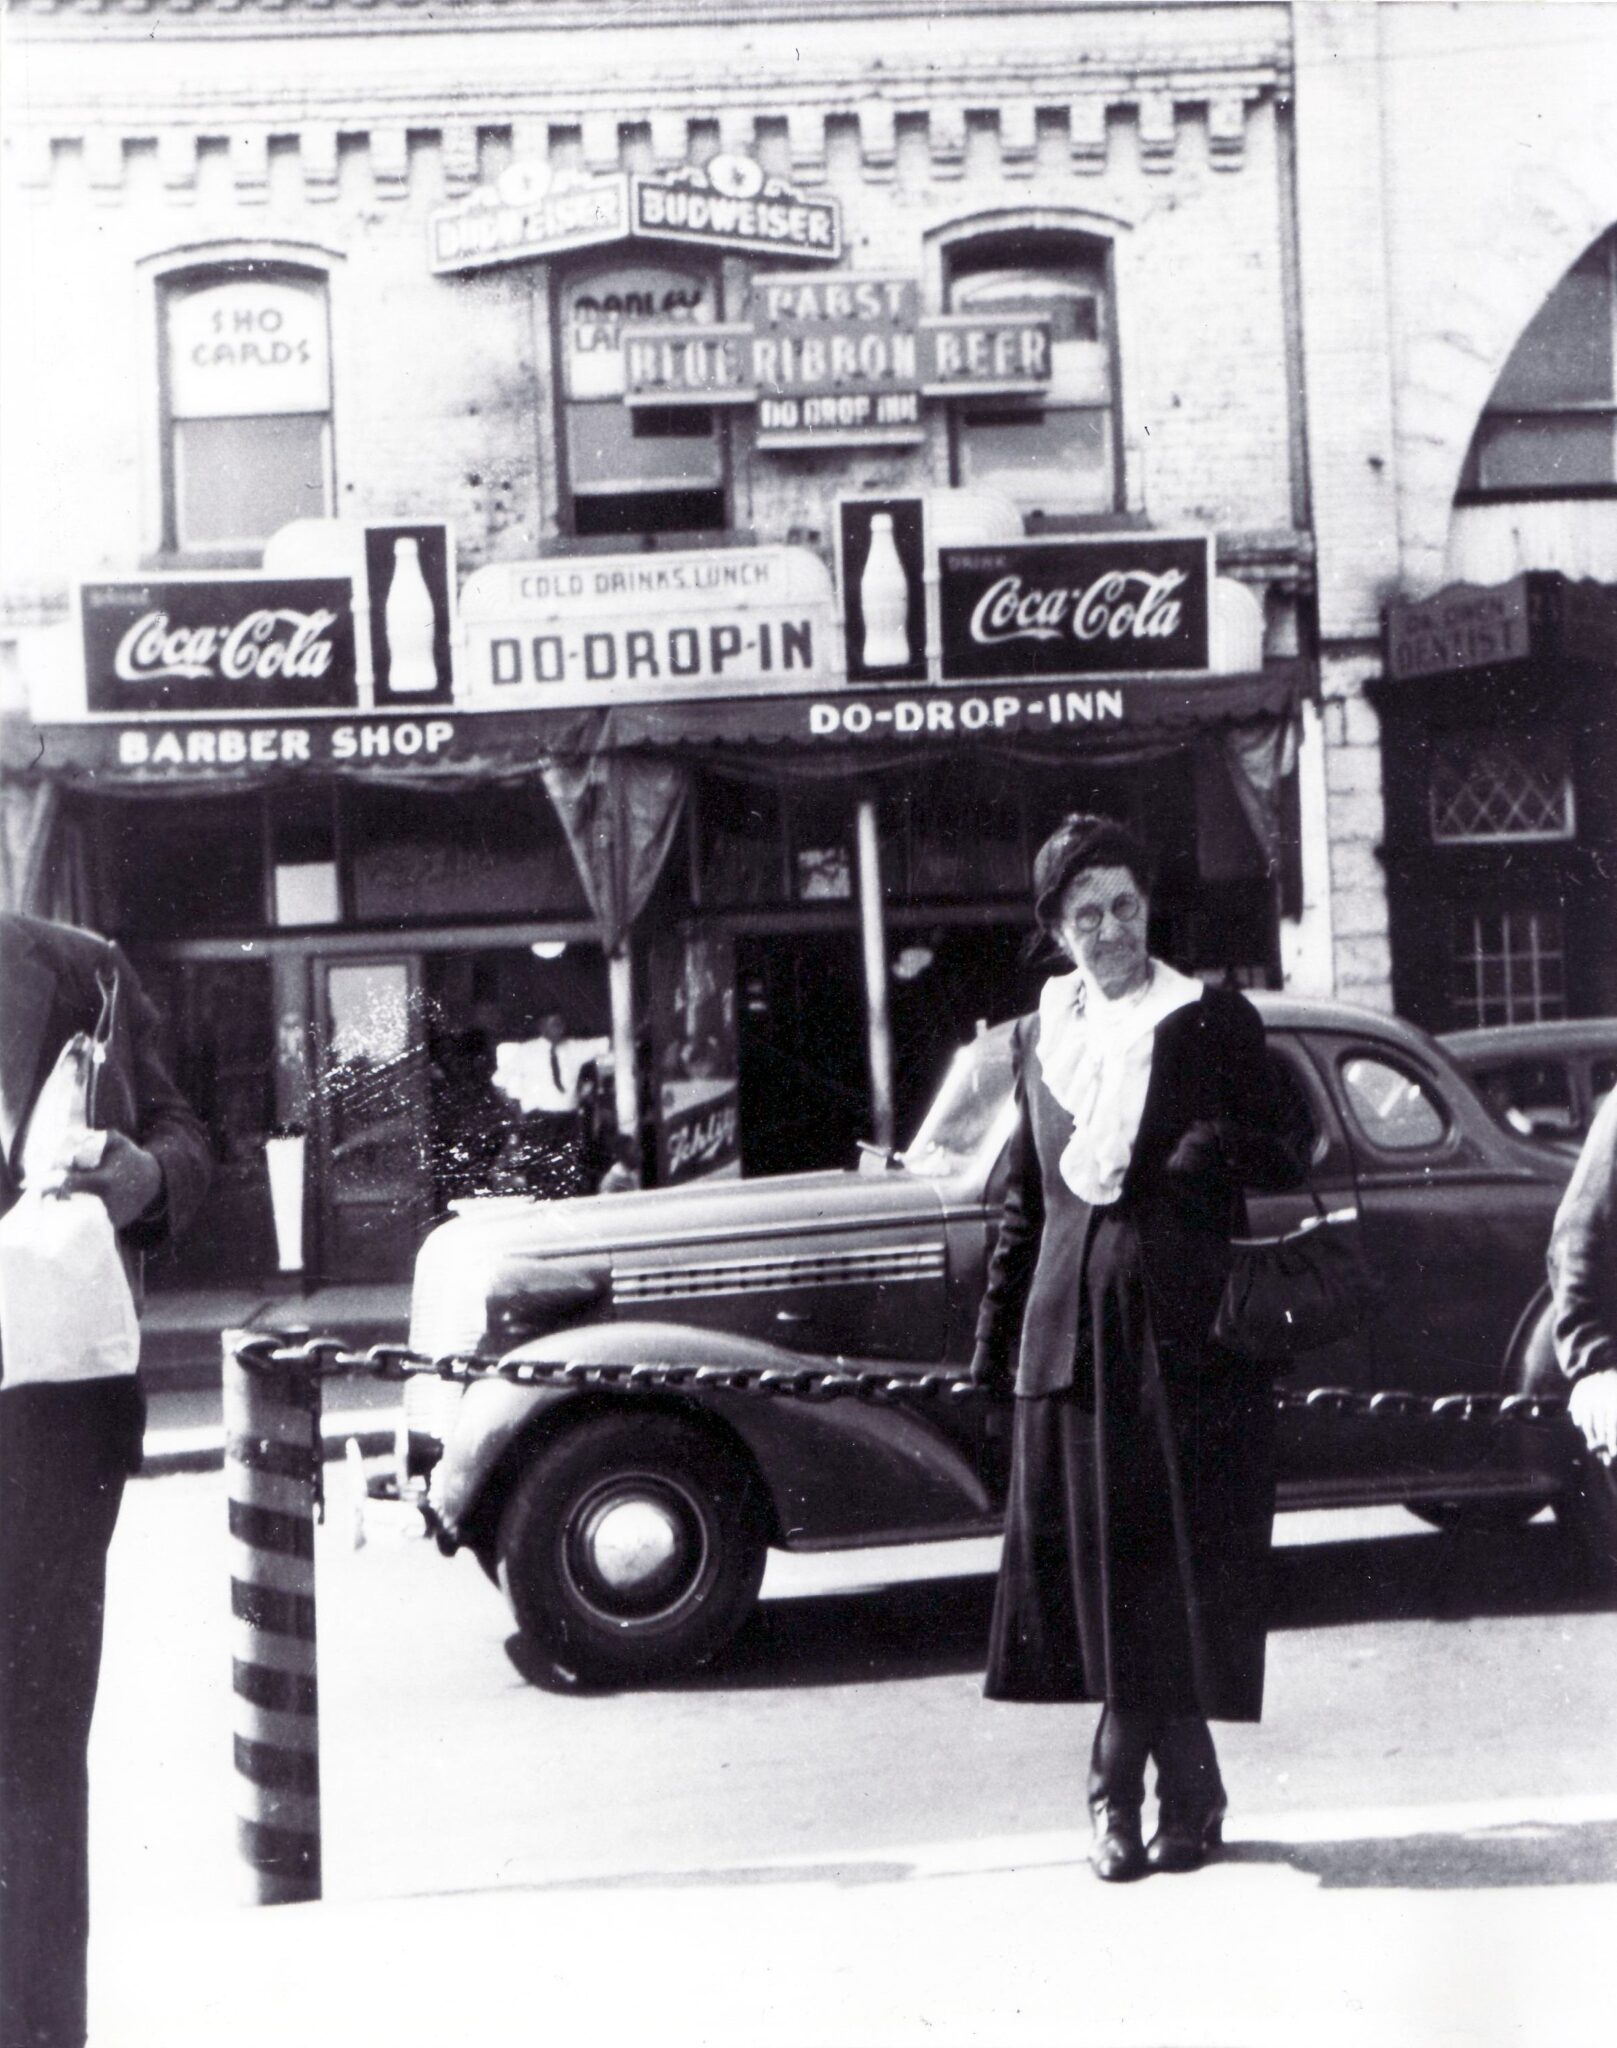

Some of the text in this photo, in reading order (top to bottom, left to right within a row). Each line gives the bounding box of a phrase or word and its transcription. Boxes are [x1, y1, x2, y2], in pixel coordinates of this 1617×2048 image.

[641, 188, 831, 245] BUDWEISER
[211, 307, 284, 334] SHO
[768, 284, 905, 320] PABST
[191, 339, 311, 367] CARDS
[630, 330, 1046, 388] BLUE RIBBON BEER
[520, 575, 583, 600] COLD
[694, 563, 770, 590] LUNCH
[490, 621, 814, 686] DO-DROP-IN
[809, 690, 1124, 735] DO-DROP-INN
[119, 721, 454, 764] BARBER SHOP
